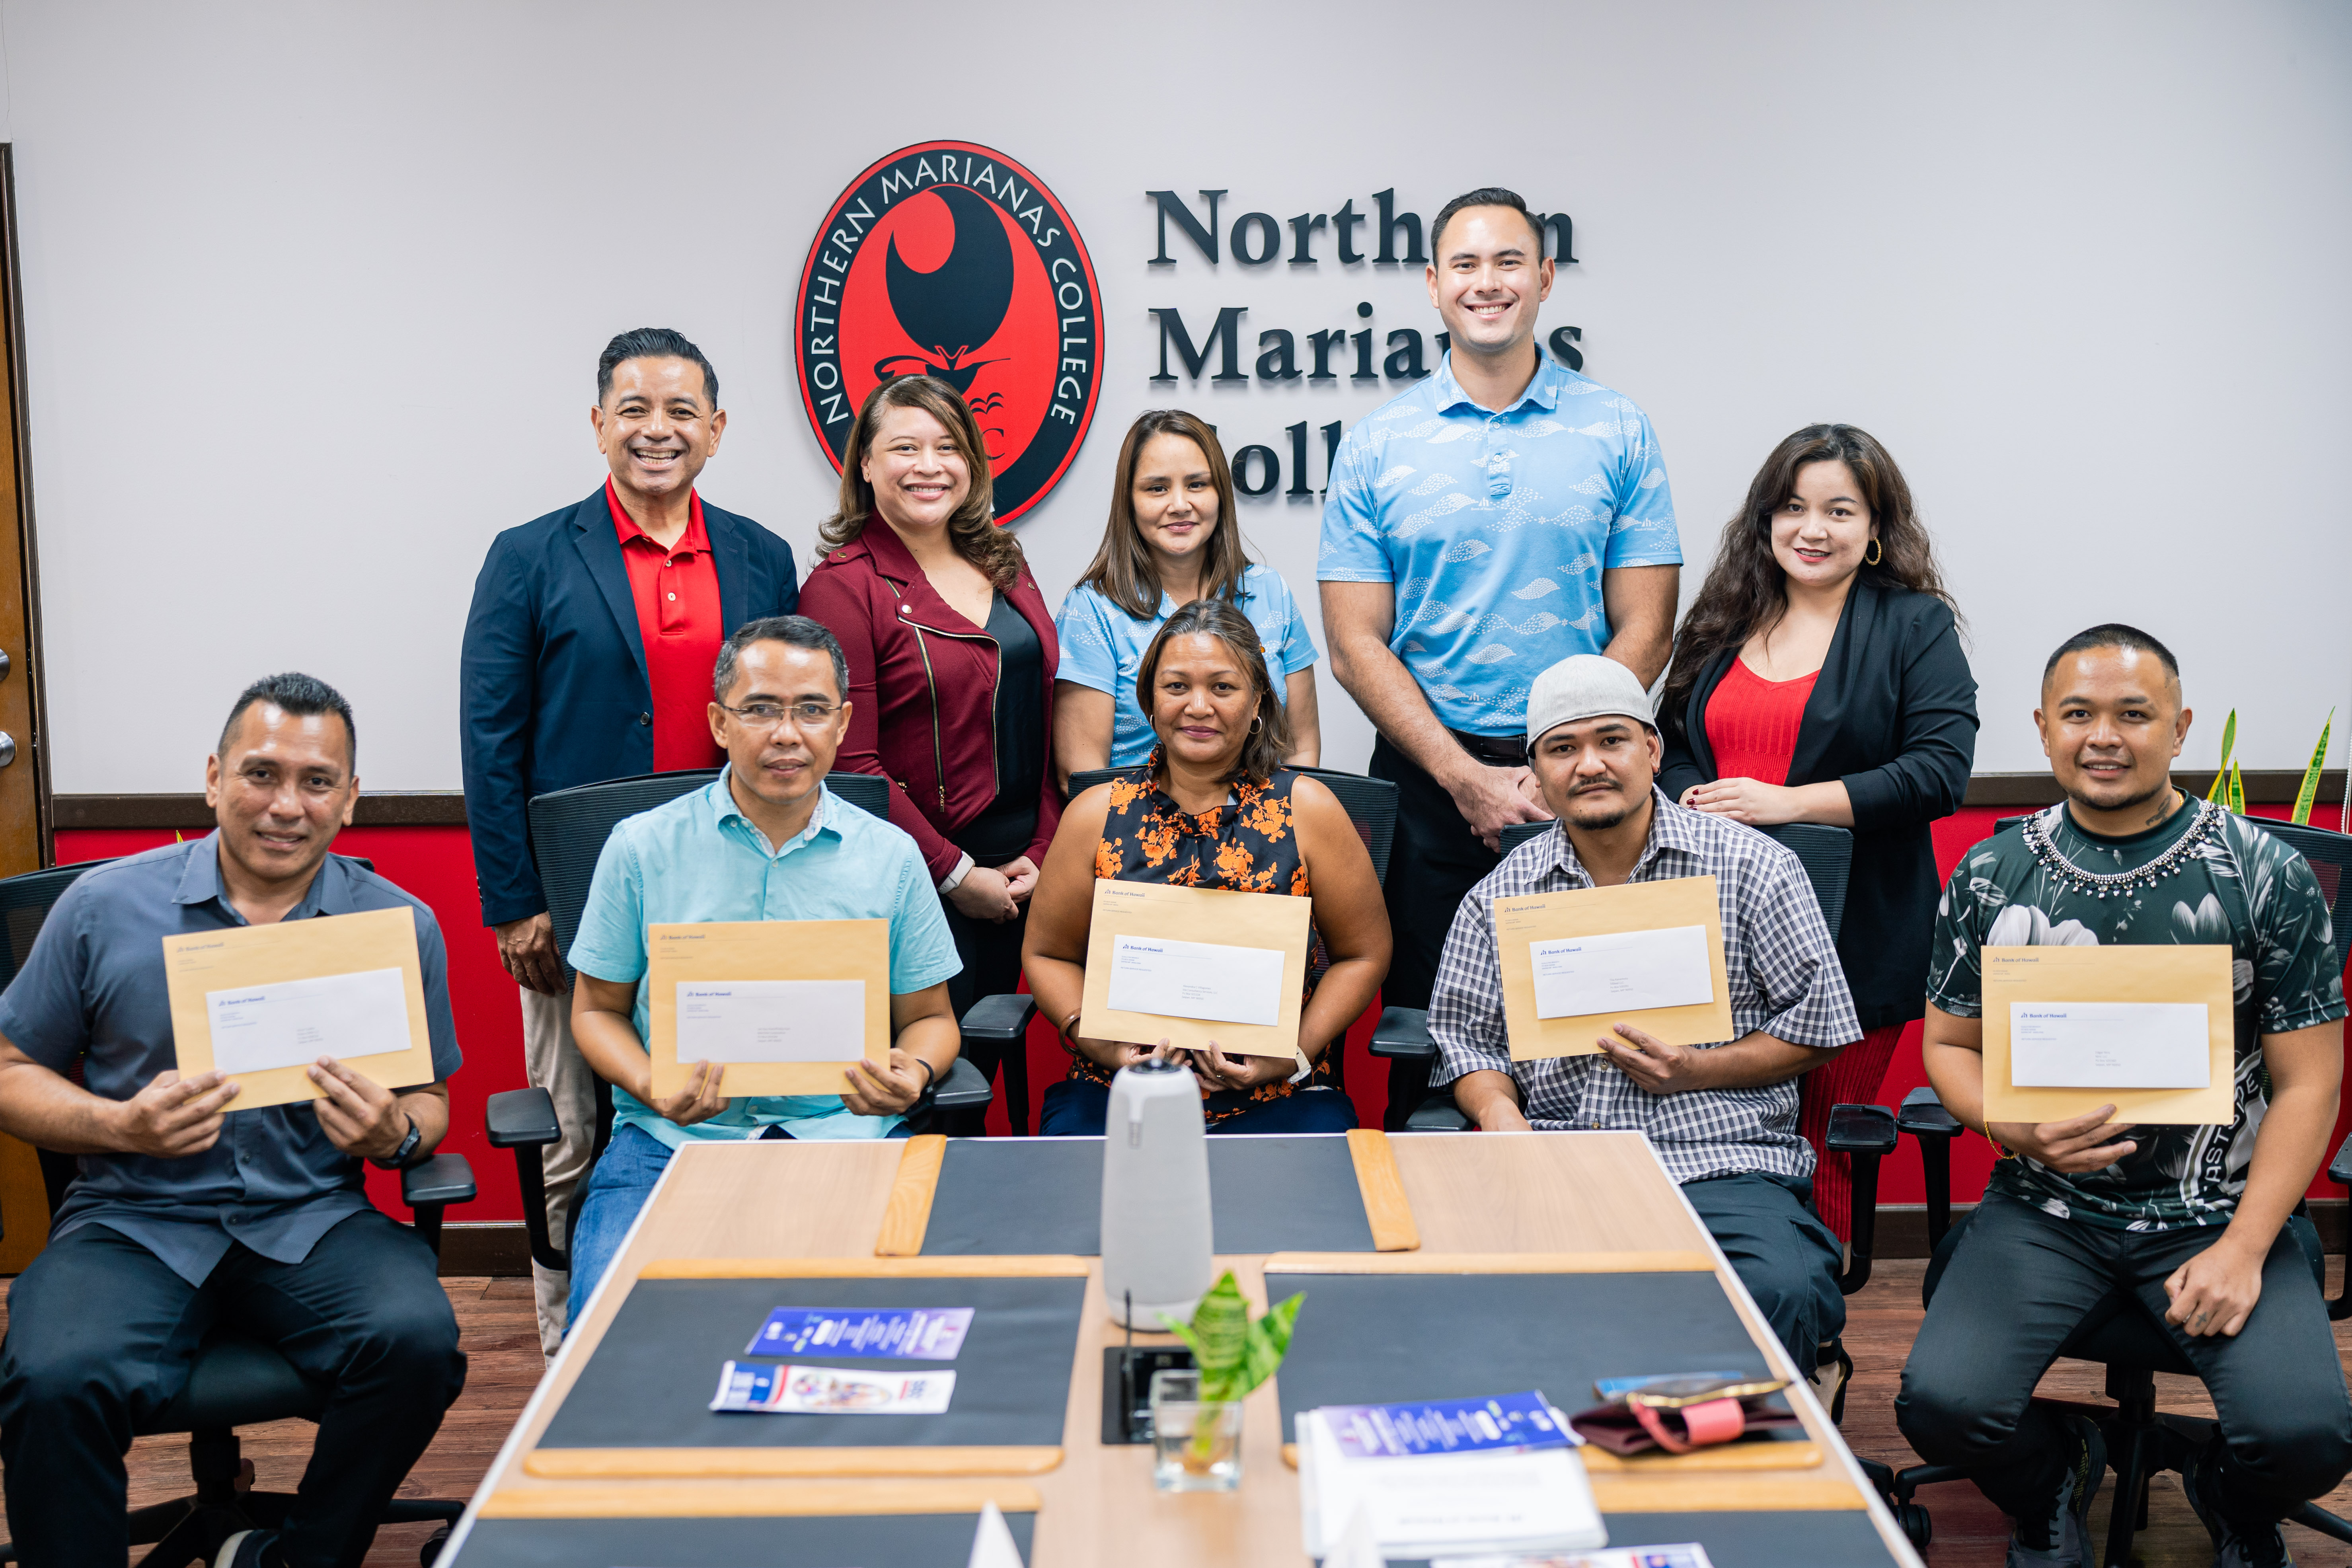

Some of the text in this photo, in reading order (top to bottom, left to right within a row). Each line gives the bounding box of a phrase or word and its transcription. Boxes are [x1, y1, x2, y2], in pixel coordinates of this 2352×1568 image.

[1146, 187, 1579, 265] Northn
[811, 155, 1087, 425] NORTHERN MARIANAS COLLEGE
[1148, 301, 1583, 380] Marias
